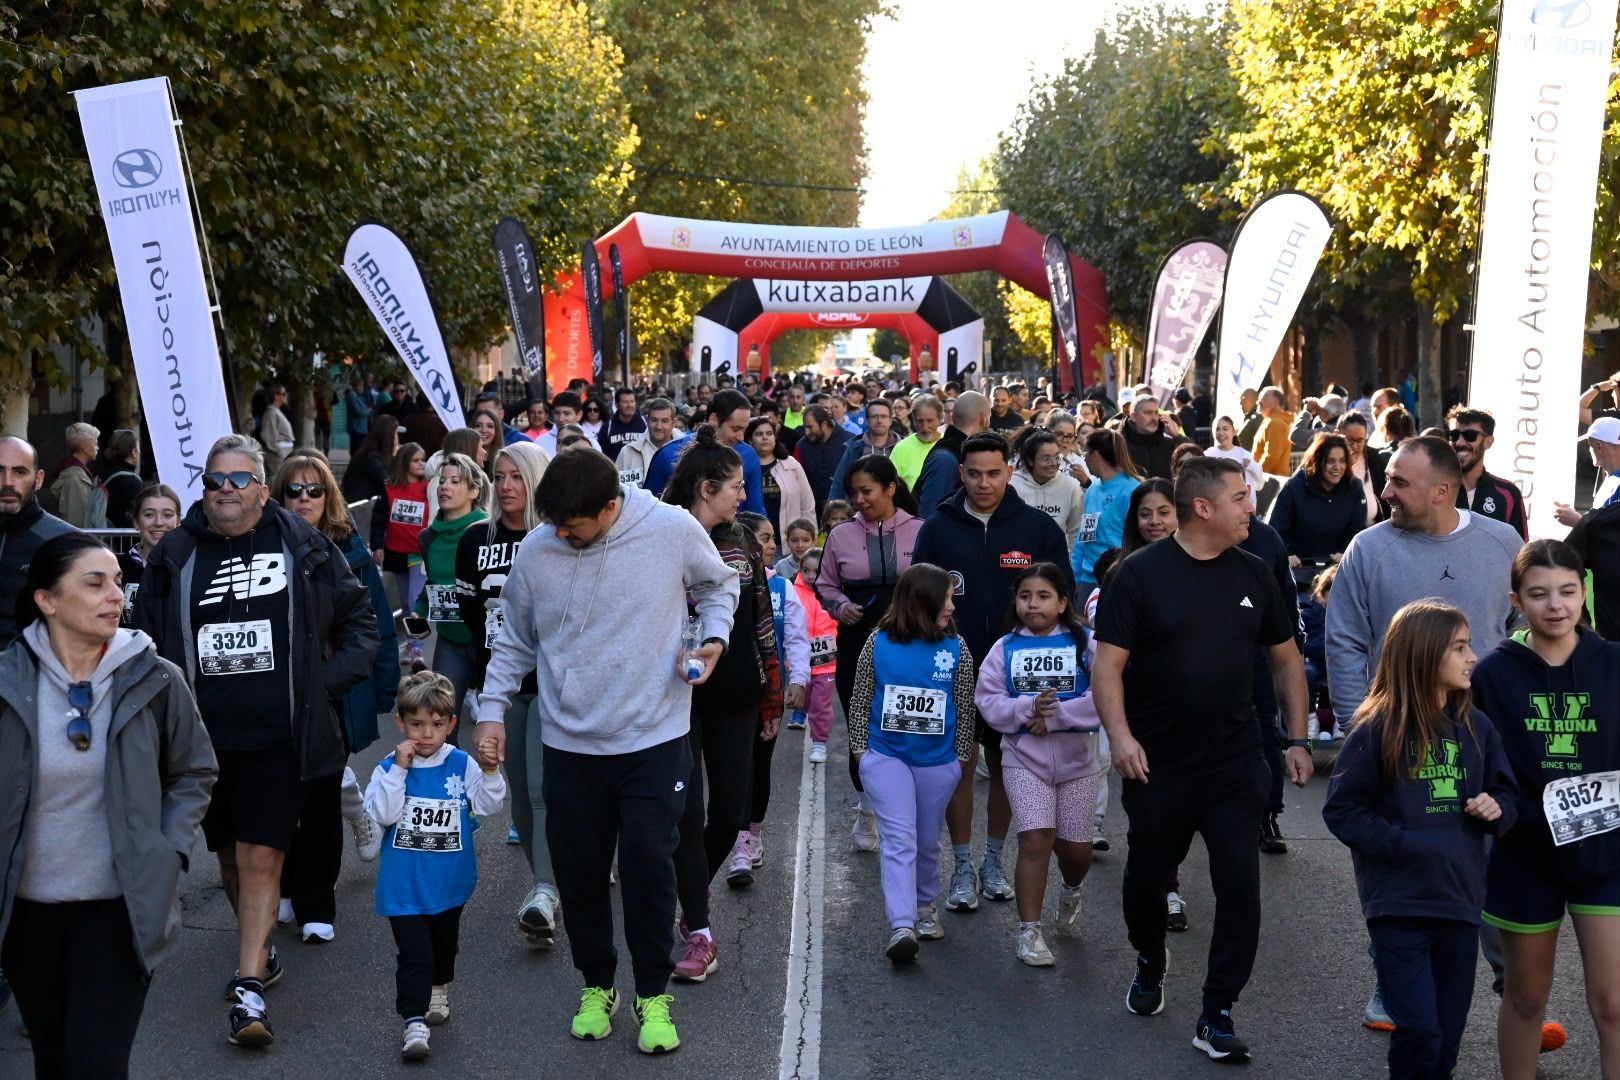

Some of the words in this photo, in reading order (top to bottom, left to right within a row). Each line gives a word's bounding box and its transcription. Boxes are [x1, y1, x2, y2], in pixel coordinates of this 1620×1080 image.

[1507, 32, 1603, 56] YUNDAI
[1518, 84, 1562, 334] Automoción
[720, 236, 850, 253] AYUNTAMIENTO
[856, 238, 876, 252] DE
[881, 233, 923, 250] LEÓN
[745, 258, 816, 271] CONCEJALÍA
[821, 260, 836, 271] DE
[840, 258, 900, 270] DEPORTES
[769, 278, 915, 303] kutxabank
[1247, 222, 1311, 342] HYUNDAI
[567, 309, 582, 369] DEPORTES
[620, 473, 640, 483] 5394
[398, 503, 417, 514] 3287
[212, 630, 257, 651] 3320
[1024, 656, 1063, 672] 3266
[896, 694, 934, 713] 3302
[1541, 761, 1564, 769] SINCE
[1555, 781, 1602, 811] 3552
[411, 807, 451, 827] 3347
[1425, 805, 1449, 814] SINCE
